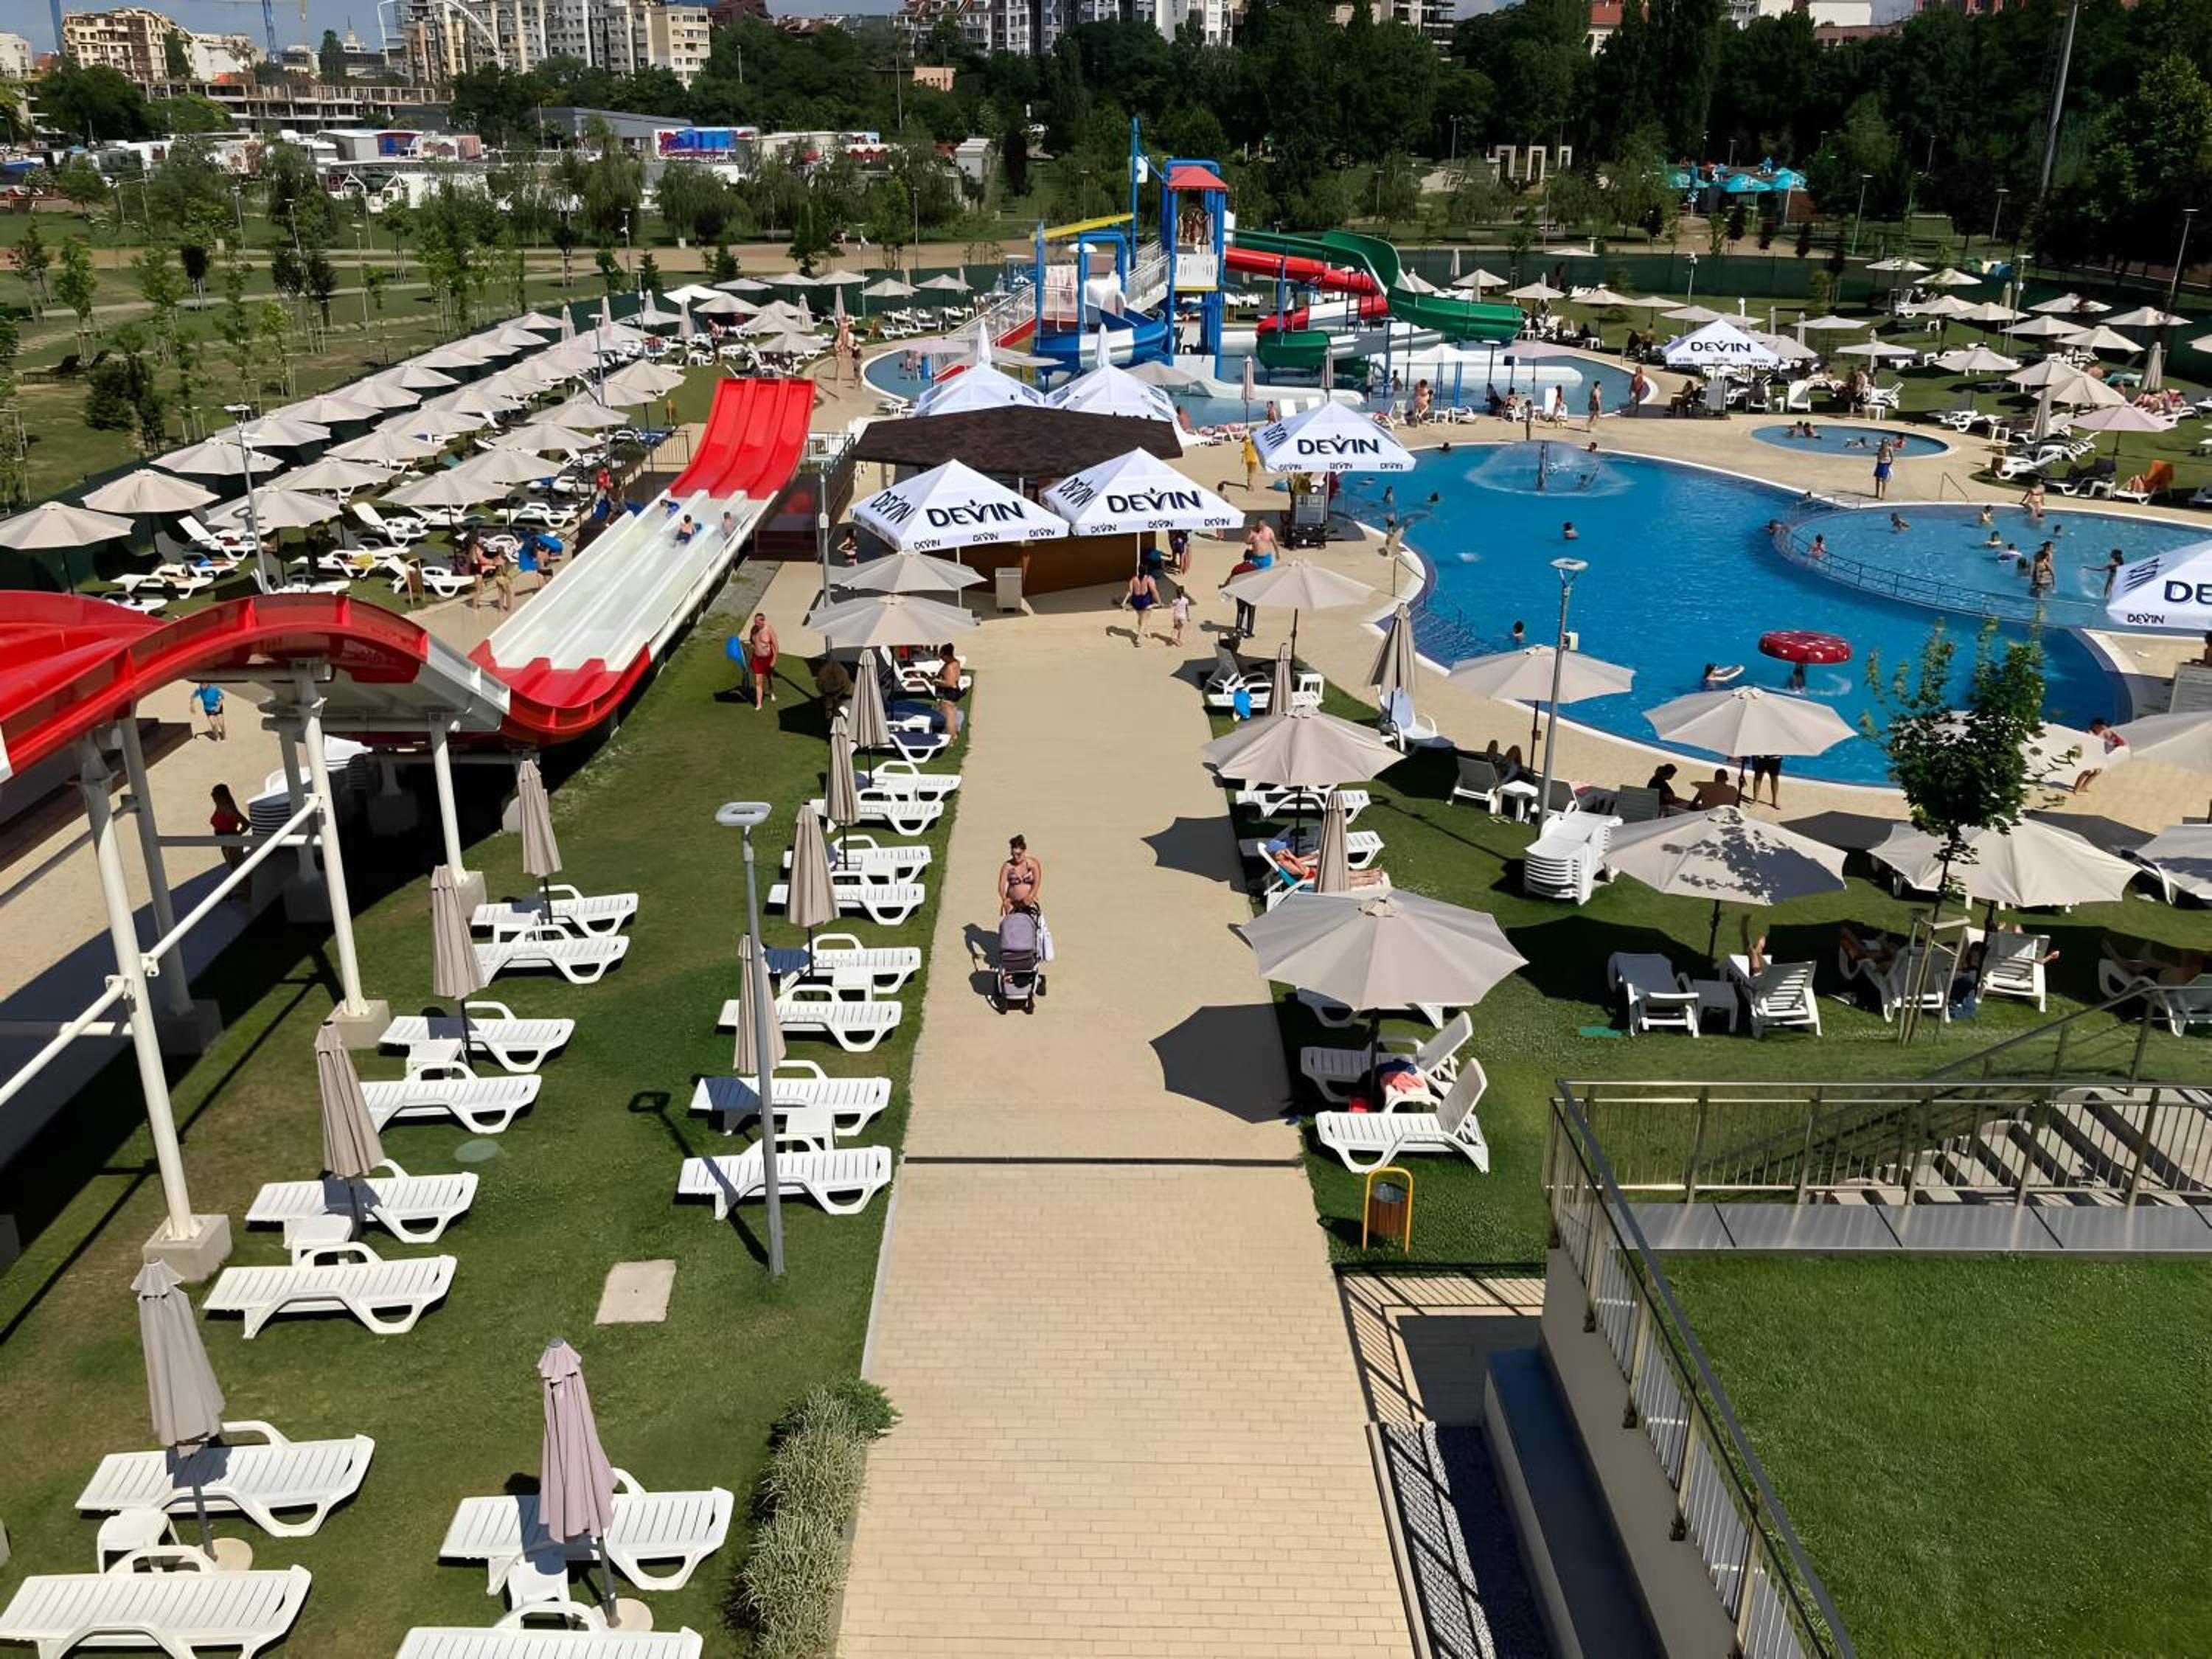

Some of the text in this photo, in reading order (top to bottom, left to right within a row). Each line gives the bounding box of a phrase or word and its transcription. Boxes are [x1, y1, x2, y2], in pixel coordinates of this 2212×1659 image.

[1691, 340, 1751, 352] DEVIN
[1297, 434, 1380, 455] DEVIN
[1107, 487, 1204, 513] DEVIN
[926, 498, 1027, 527] DEVIN
[2126, 613, 2165, 625] DEVIN
